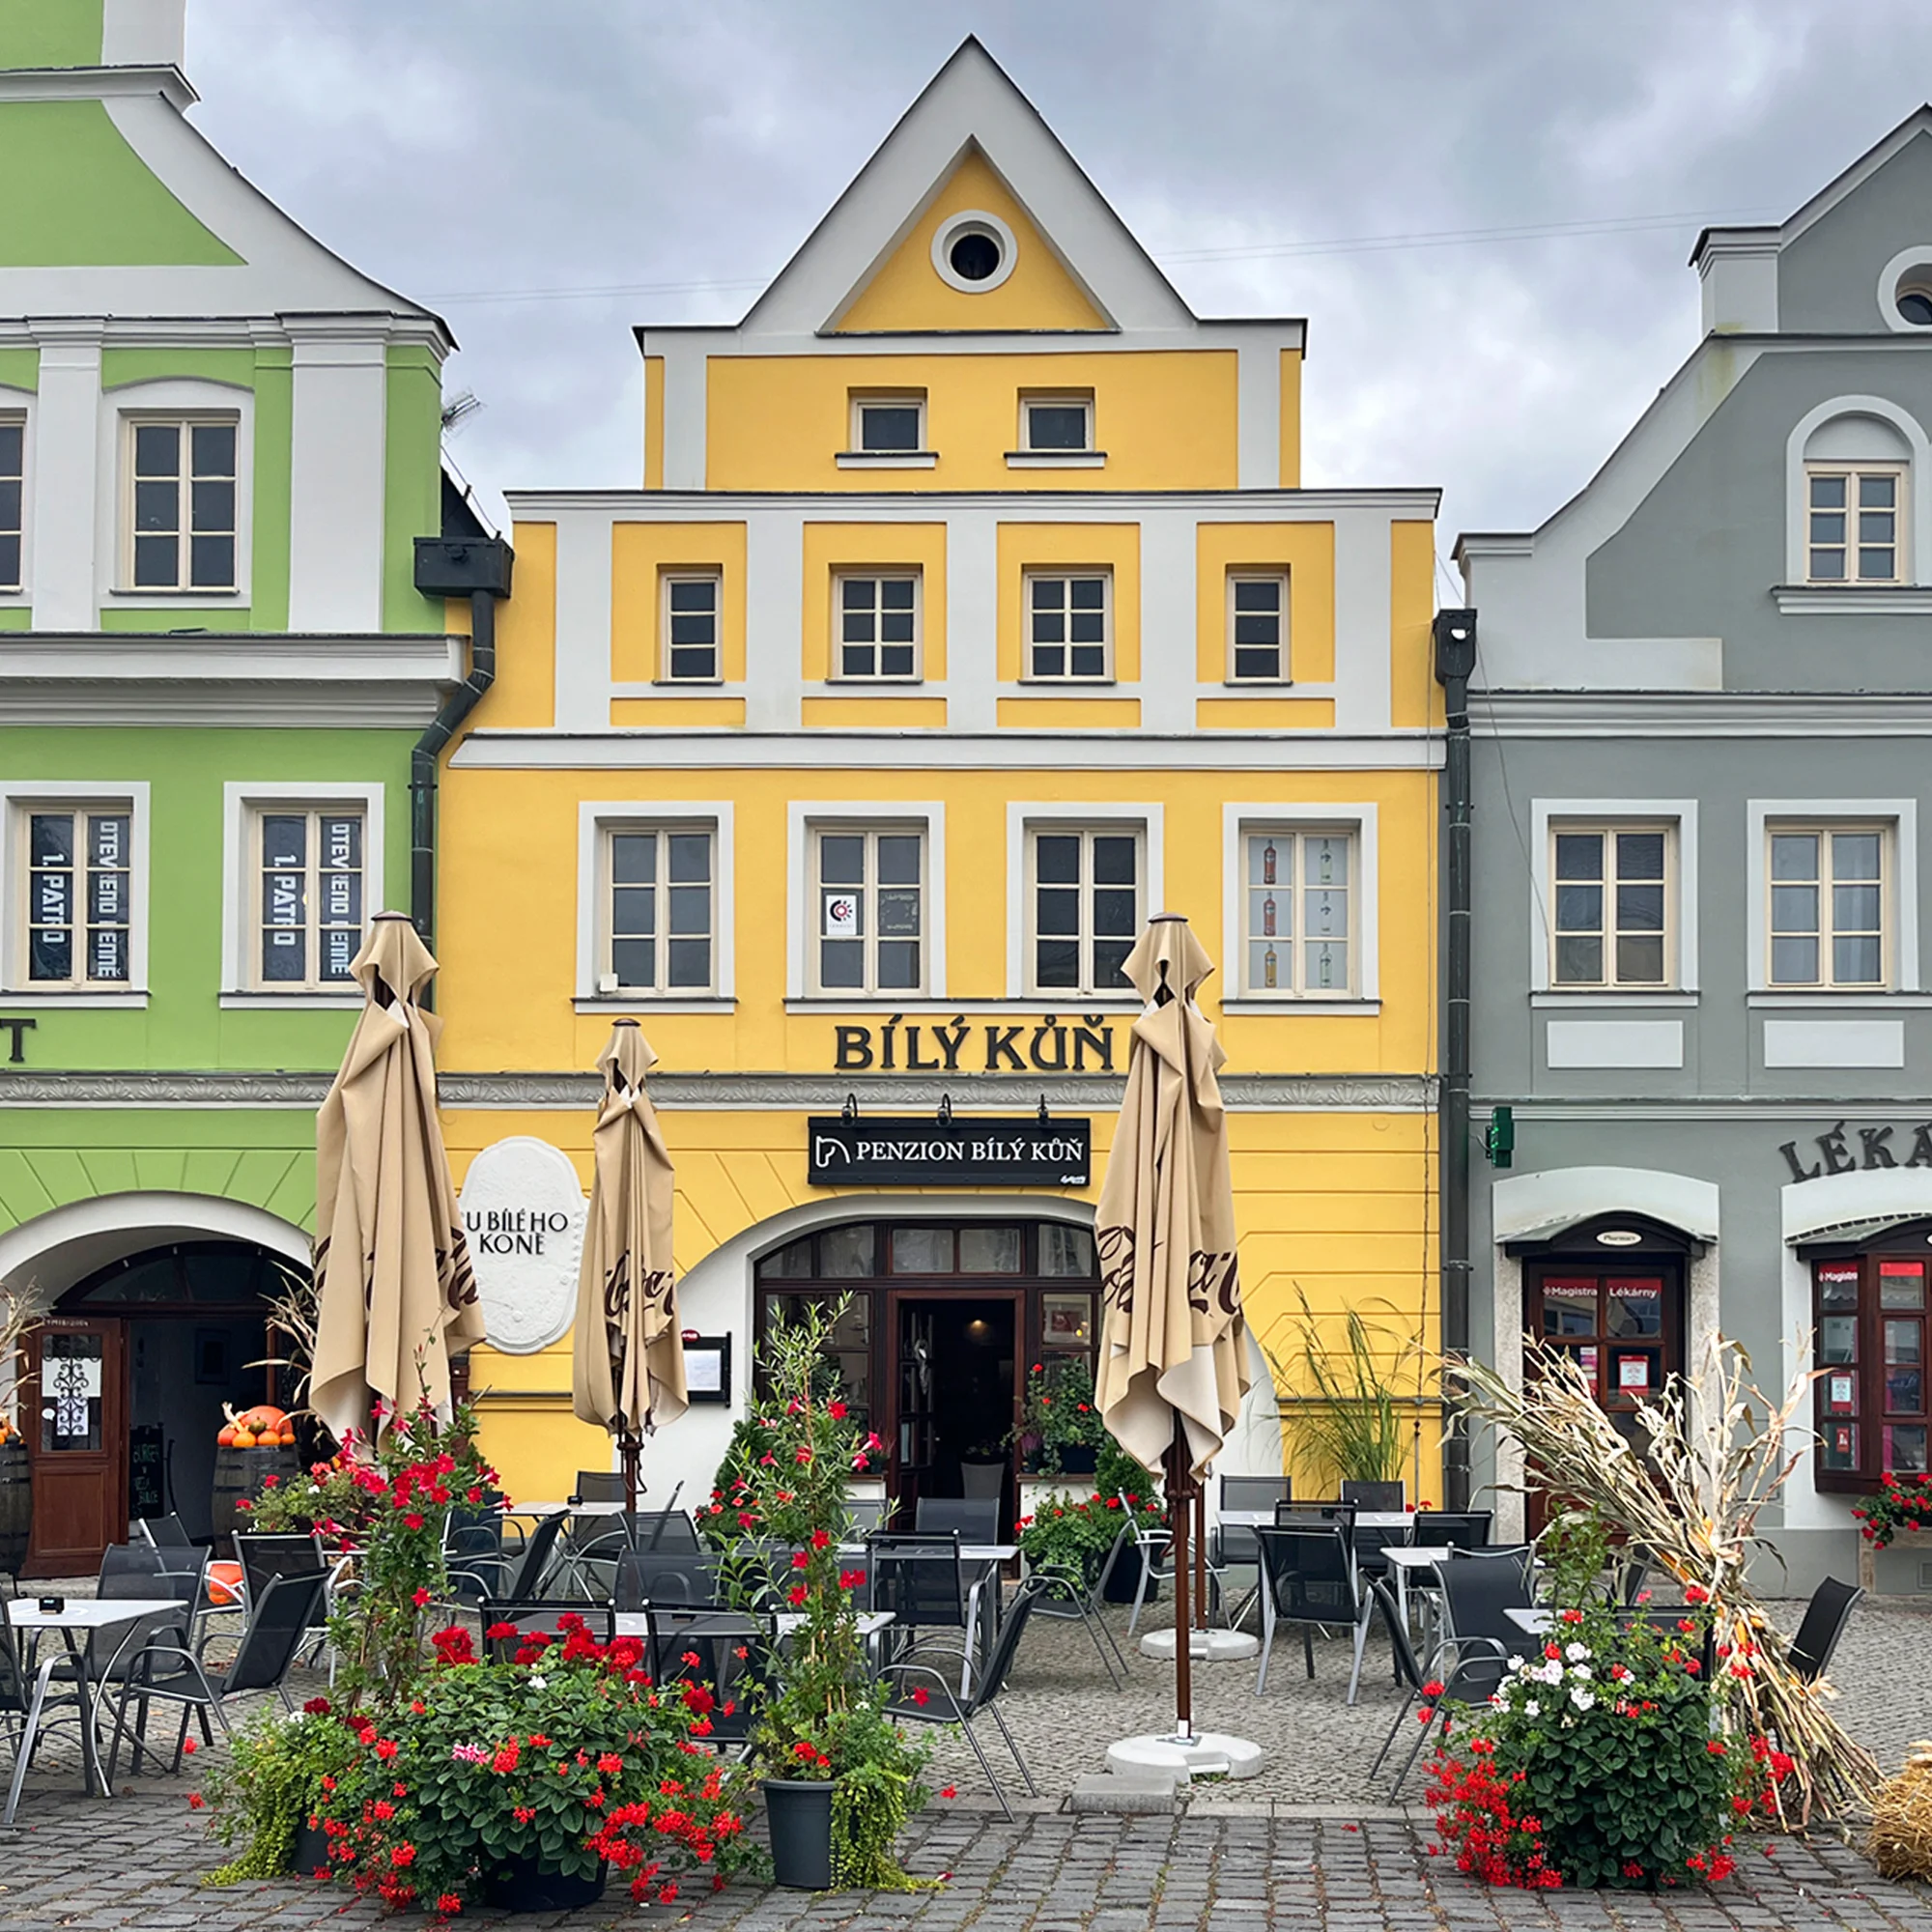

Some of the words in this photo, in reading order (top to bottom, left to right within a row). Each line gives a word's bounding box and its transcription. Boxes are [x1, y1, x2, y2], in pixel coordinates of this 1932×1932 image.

[43, 853, 65, 867] 1.
[274, 854, 297, 867] 1.
[834, 1013, 971, 1069] BÍLÝ
[984, 1014, 1114, 1070] KŮŇ
[856, 1141, 965, 1160] PENZION
[971, 1137, 1026, 1160] BÍLÝ
[1031, 1138, 1084, 1161] KŮŇ
[467, 1211, 481, 1232] U
[1551, 1287, 1598, 1297] Magistra
[1608, 1287, 1658, 1298] Lékárny
